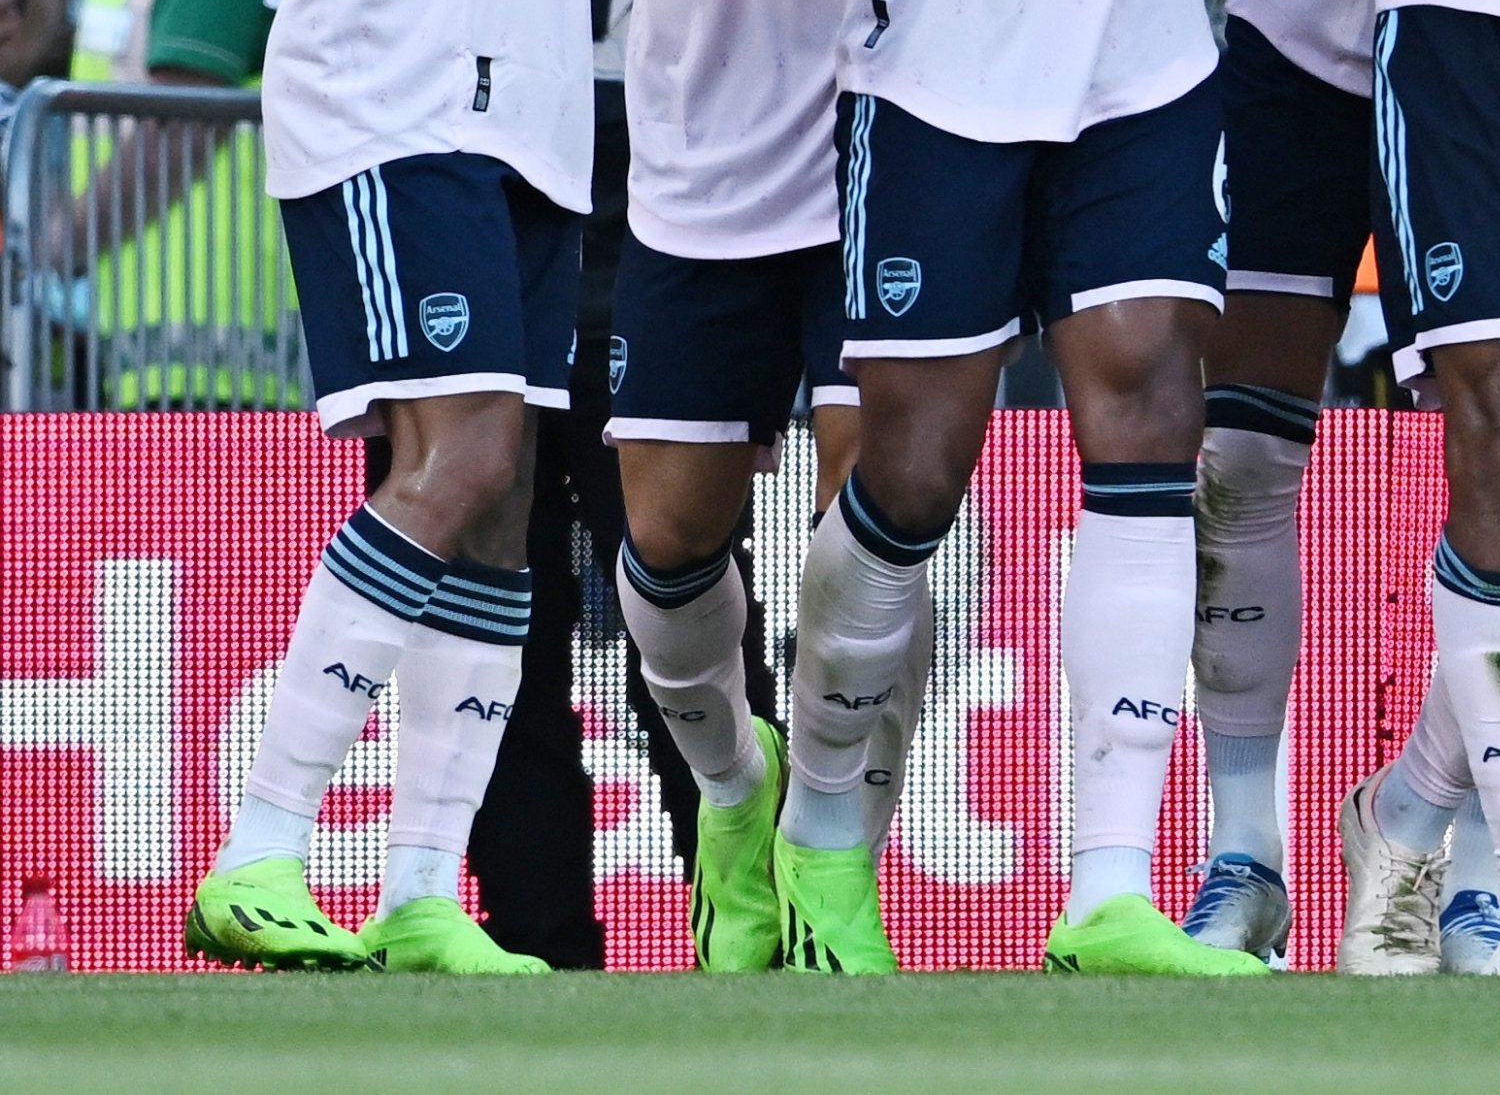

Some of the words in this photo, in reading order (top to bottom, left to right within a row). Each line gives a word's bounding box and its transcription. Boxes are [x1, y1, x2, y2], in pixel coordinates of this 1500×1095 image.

[427, 303, 462, 314] Arsenal
[822, 686, 894, 709] AFC
[662, 706, 706, 722] FC
[1112, 697, 1179, 726] AFC
